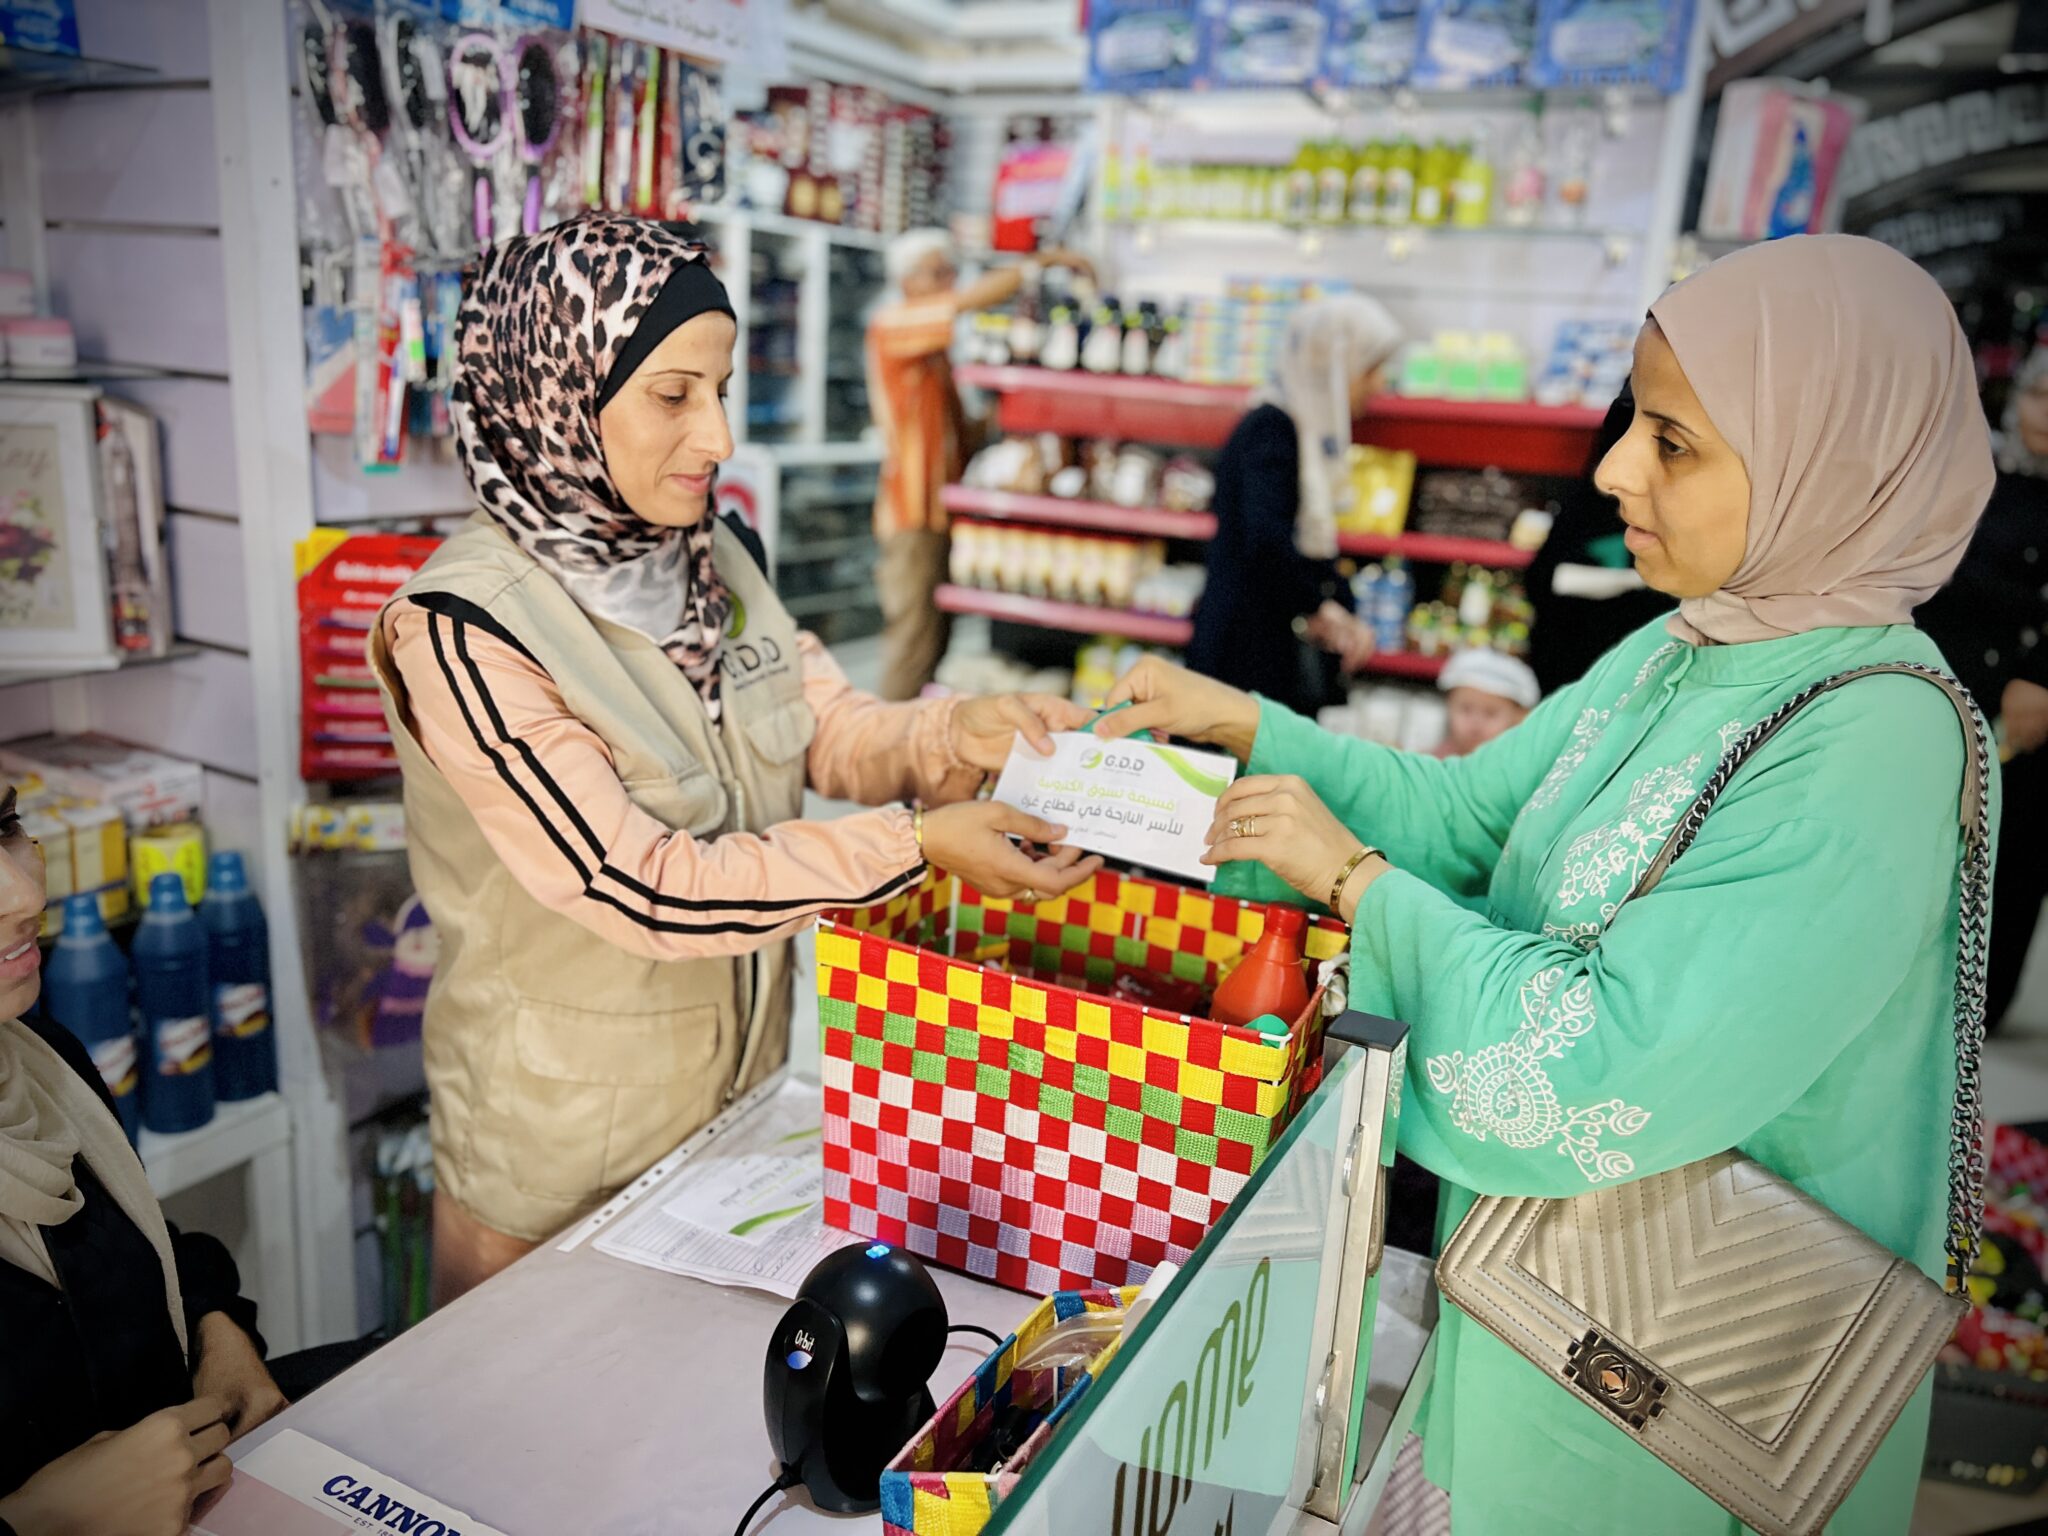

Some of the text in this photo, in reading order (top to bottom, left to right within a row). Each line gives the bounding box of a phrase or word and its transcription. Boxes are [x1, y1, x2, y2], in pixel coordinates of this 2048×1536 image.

[1104, 754, 1145, 772] G.D.D
[1042, 798, 1075, 814] قطاع
[1078, 804, 1101, 819] في
[1147, 817, 1184, 836] للأسر
[795, 1329, 815, 1351] Orbit
[323, 1475, 460, 1536] CANNO
